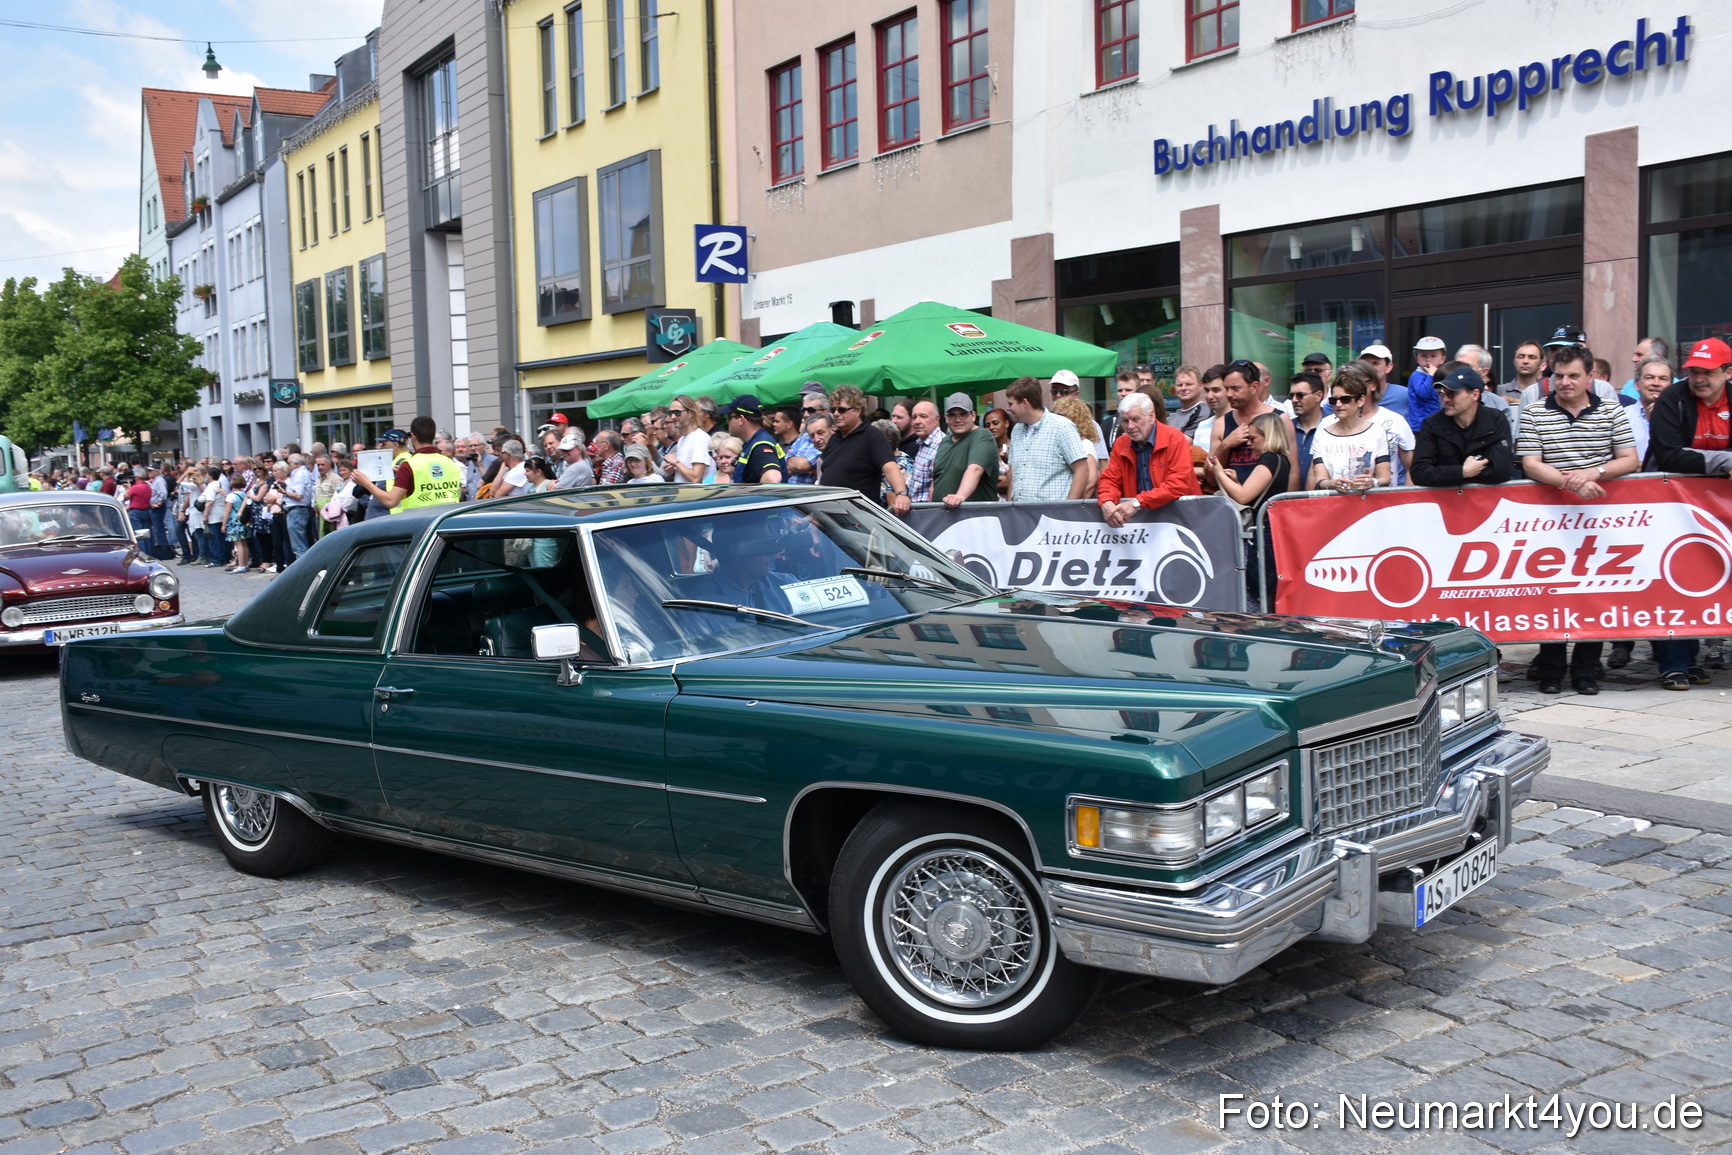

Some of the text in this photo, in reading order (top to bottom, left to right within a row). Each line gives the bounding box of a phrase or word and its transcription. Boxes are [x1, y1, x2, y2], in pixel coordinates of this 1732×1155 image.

[1154, 15, 1694, 175] Buchhandlung Rupprecht
[753, 299, 770, 310] Unterer
[771, 296, 786, 307] Markt
[667, 322, 685, 346] G2
[944, 345, 1045, 357] Lammsbräu
[950, 339, 1021, 349] Neumarkter
[420, 481, 458, 492] FOLLOW
[434, 491, 449, 500] ME
[1492, 509, 1654, 534] Autoklassik
[1037, 528, 1150, 546] Autoklassik
[1447, 535, 1645, 582] Dietz
[1007, 549, 1143, 587] Dietz
[823, 585, 852, 602] 524
[1438, 585, 1546, 600] BREITENBRUNN
[53, 631, 62, 642] N
[1425, 877, 1444, 917] AS
